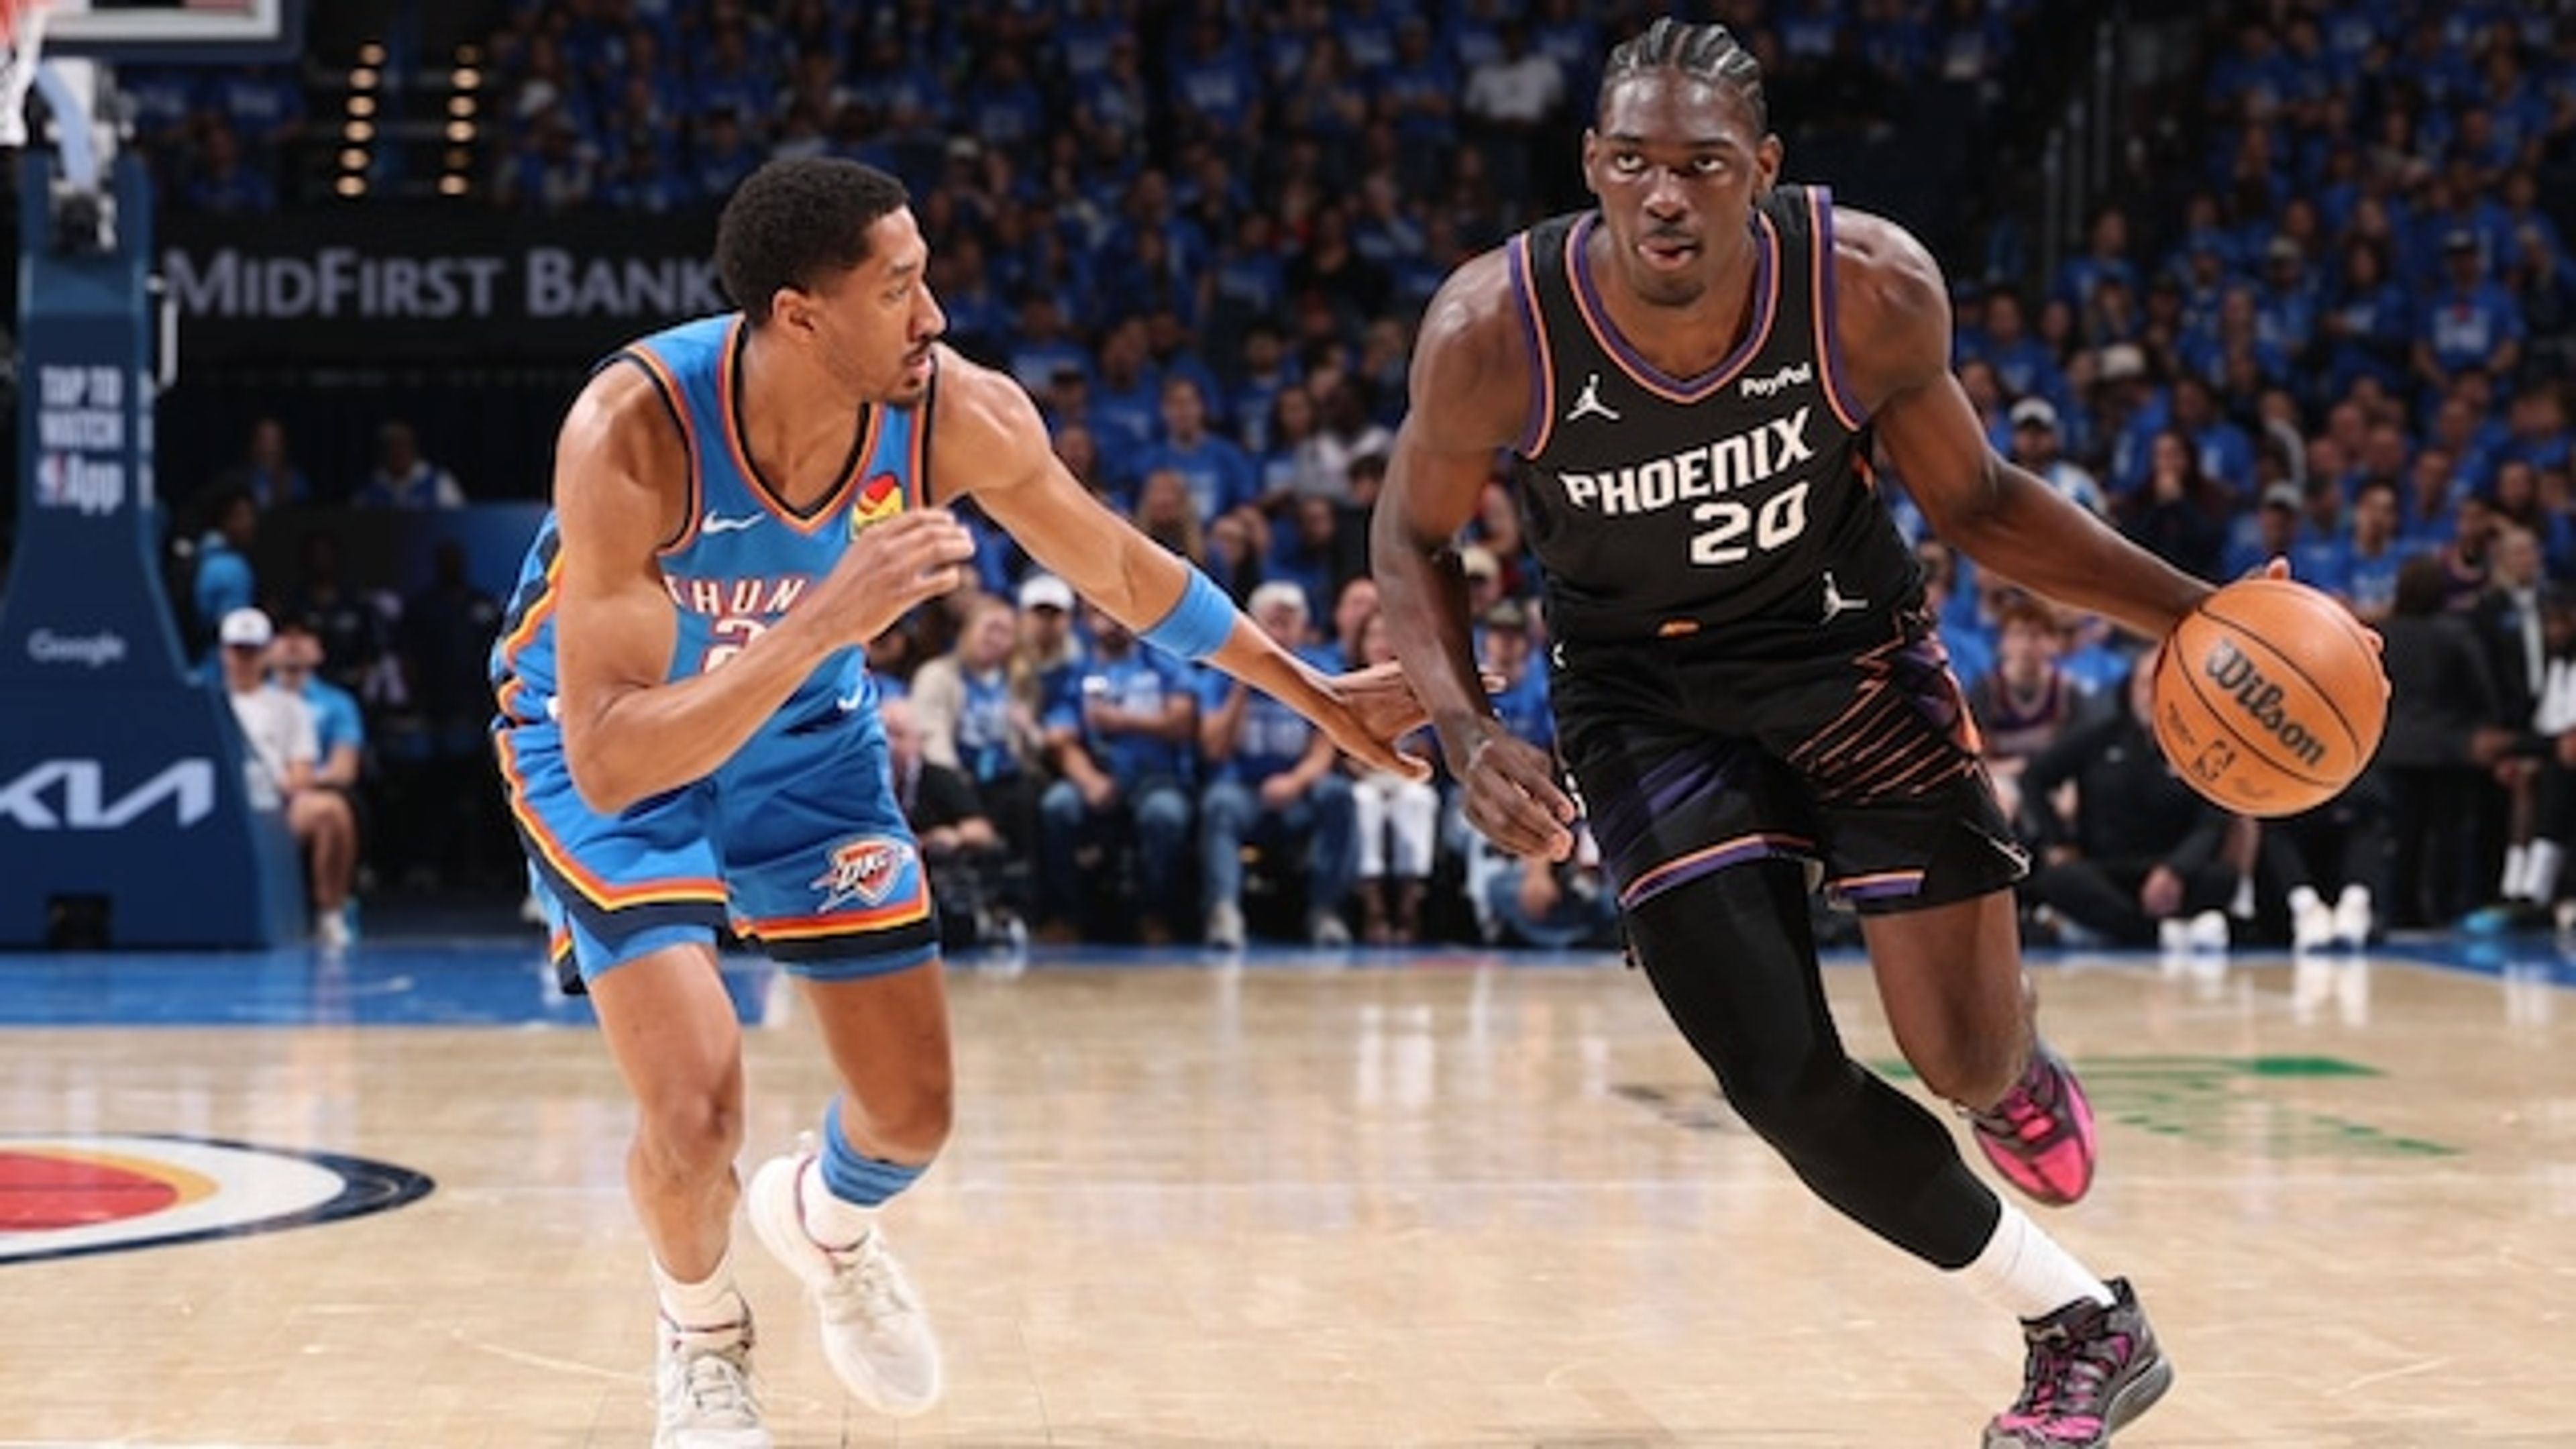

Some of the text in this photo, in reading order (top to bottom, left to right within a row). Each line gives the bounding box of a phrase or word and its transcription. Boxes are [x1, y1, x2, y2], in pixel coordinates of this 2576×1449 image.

[527, 249, 728, 318] BANK
[1741, 362, 1811, 397] PayPal
[38, 410, 125, 449] WATCH
[1559, 406, 1813, 515] PHOENIX
[1690, 482, 1809, 565] 20
[28, 629, 127, 666] Google
[2206, 637, 2326, 767] Wilson
